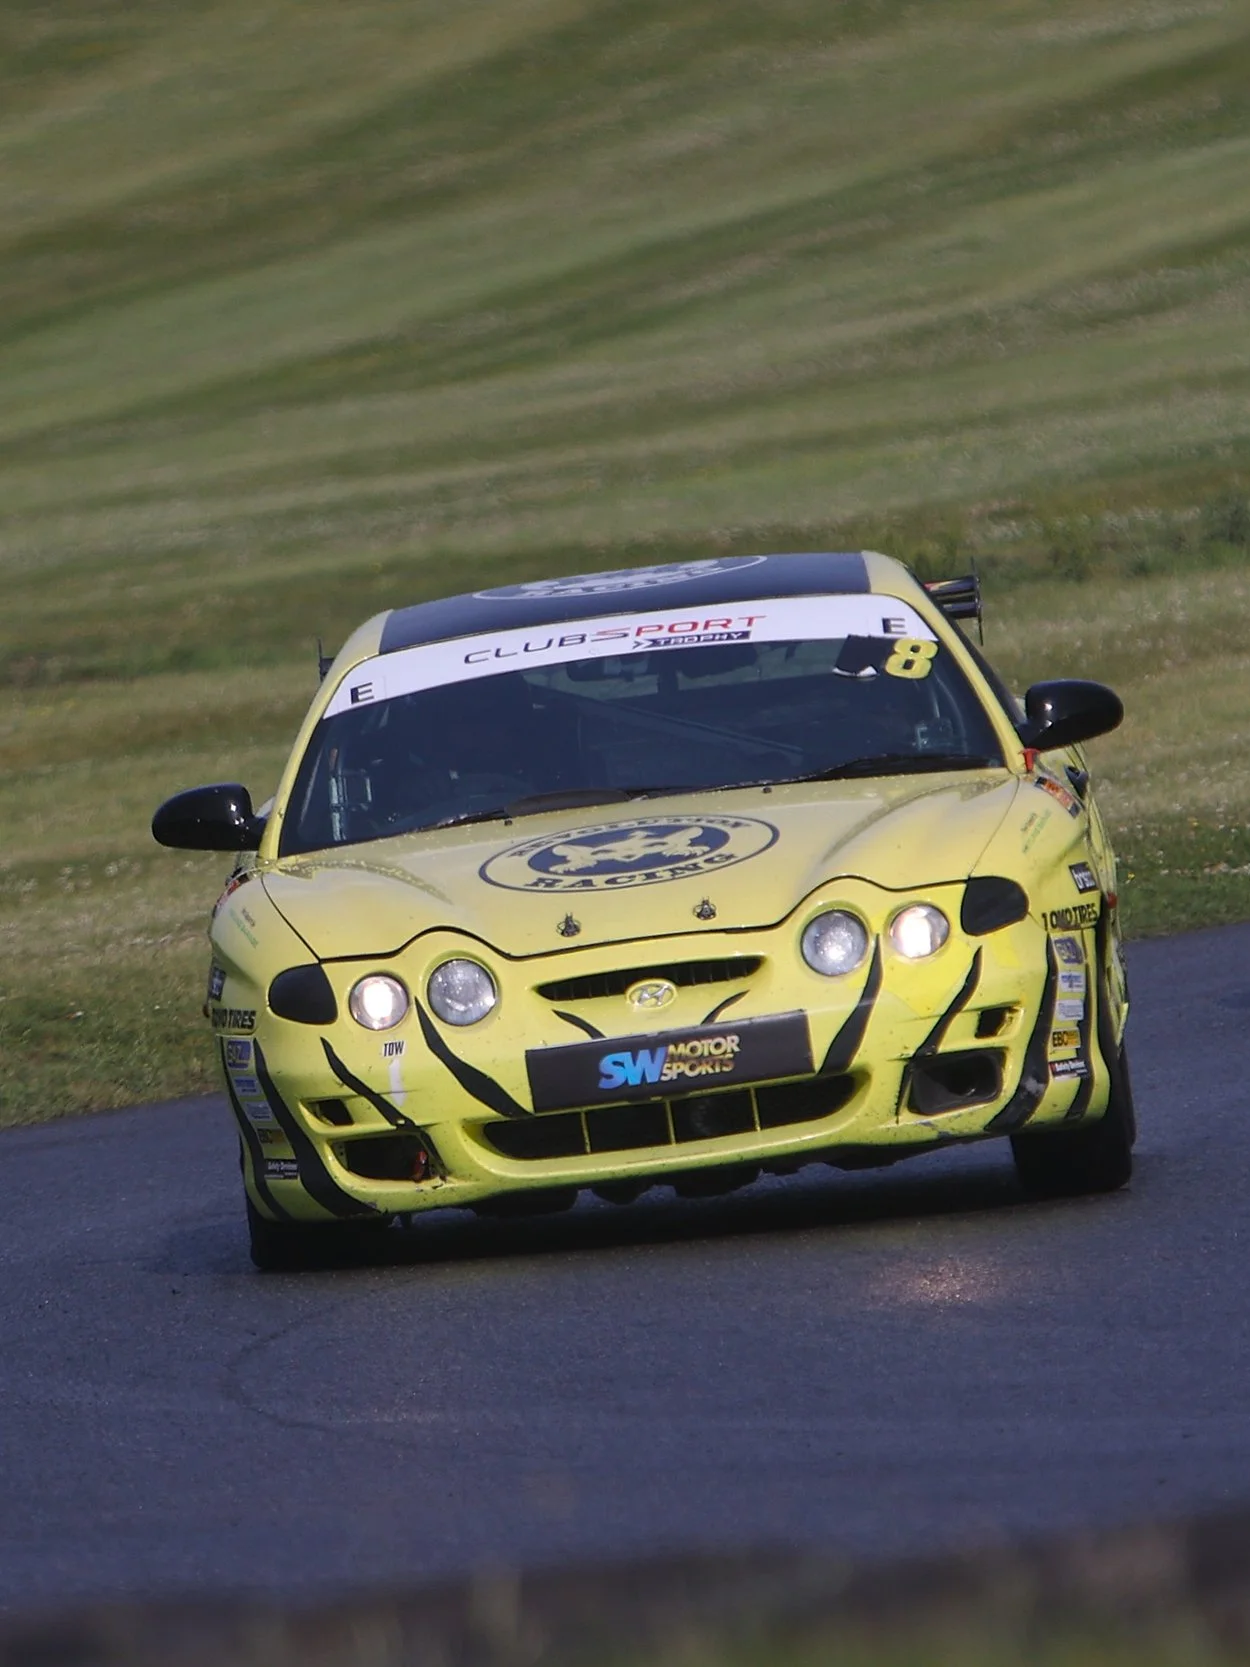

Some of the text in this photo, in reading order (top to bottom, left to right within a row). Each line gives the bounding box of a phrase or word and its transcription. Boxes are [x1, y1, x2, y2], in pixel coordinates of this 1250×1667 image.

[882, 617, 907, 635] E
[464, 614, 768, 665] CLUBSPORT
[655, 630, 744, 648] TROPHY
[884, 637, 939, 680] 8
[349, 682, 374, 706] E
[523, 852, 738, 889] RACING
[228, 1009, 257, 1031] TIRES
[382, 1040, 405, 1057] TOW
[666, 1034, 742, 1059] MOTOR
[597, 1046, 667, 1090] SW
[661, 1054, 735, 1083] SPORTS
